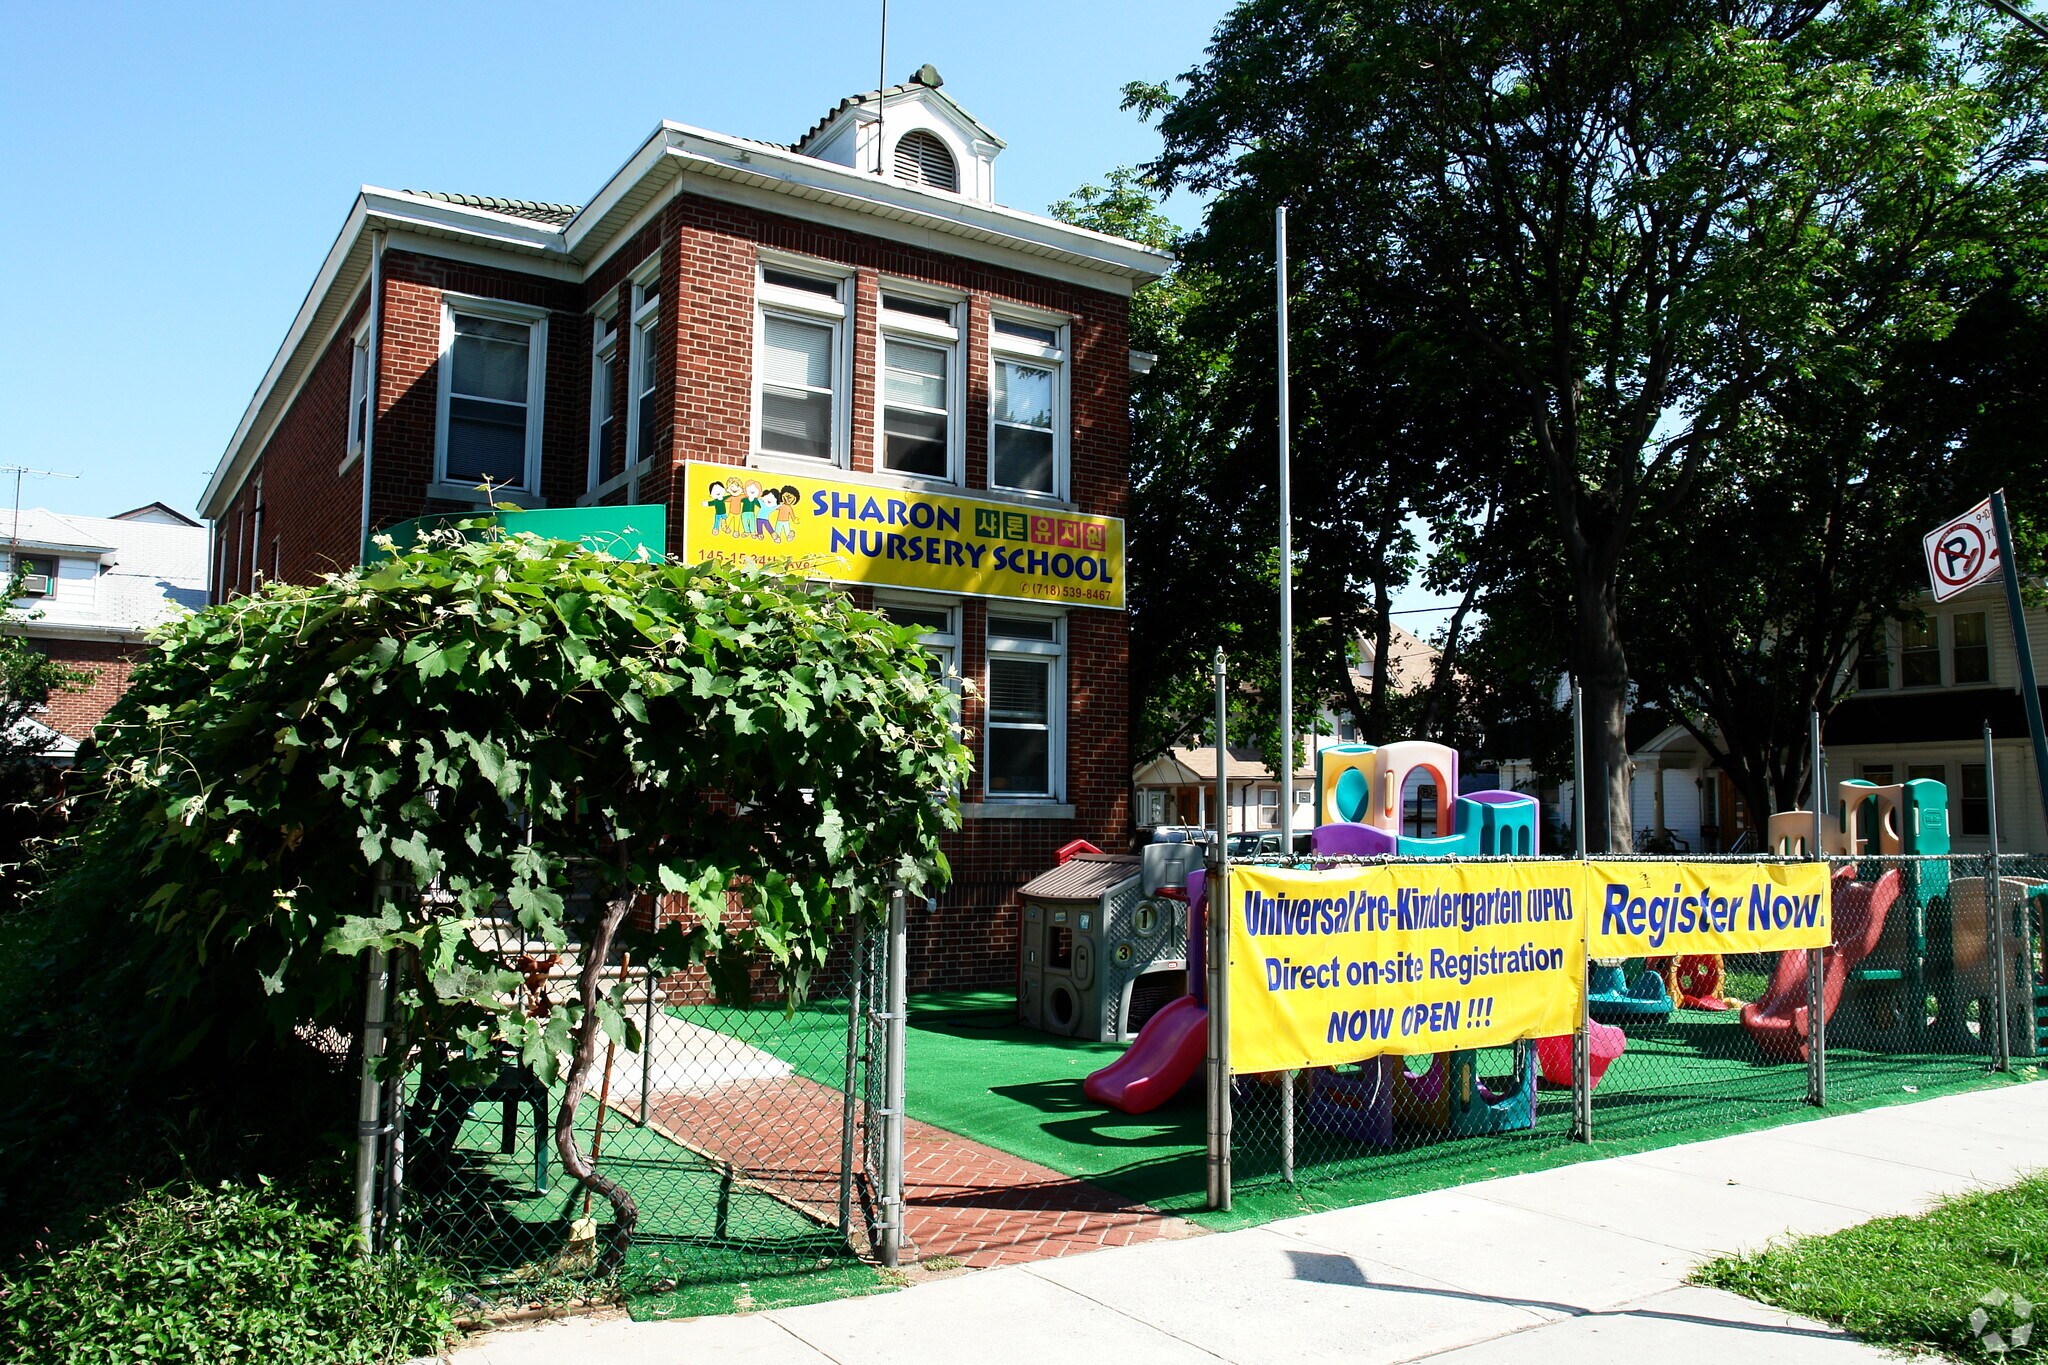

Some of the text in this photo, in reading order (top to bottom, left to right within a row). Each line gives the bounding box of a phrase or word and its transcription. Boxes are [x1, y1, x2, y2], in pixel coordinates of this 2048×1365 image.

[812, 490, 960, 533] SHARON
[830, 527, 1113, 583] NURSERY SCHOOL
[1032, 584, 1112, 601] (718) 539-8467
[1140, 910, 1148, 928] 1
[1245, 887, 1573, 936] Universal Pre-Kindergarten (UPK)
[1601, 883, 1743, 947] Register
[1119, 947, 1128, 960] 3
[1265, 942, 1563, 991] Direct on-site Registration
[1327, 997, 1493, 1043] NOW OPEN !!!
